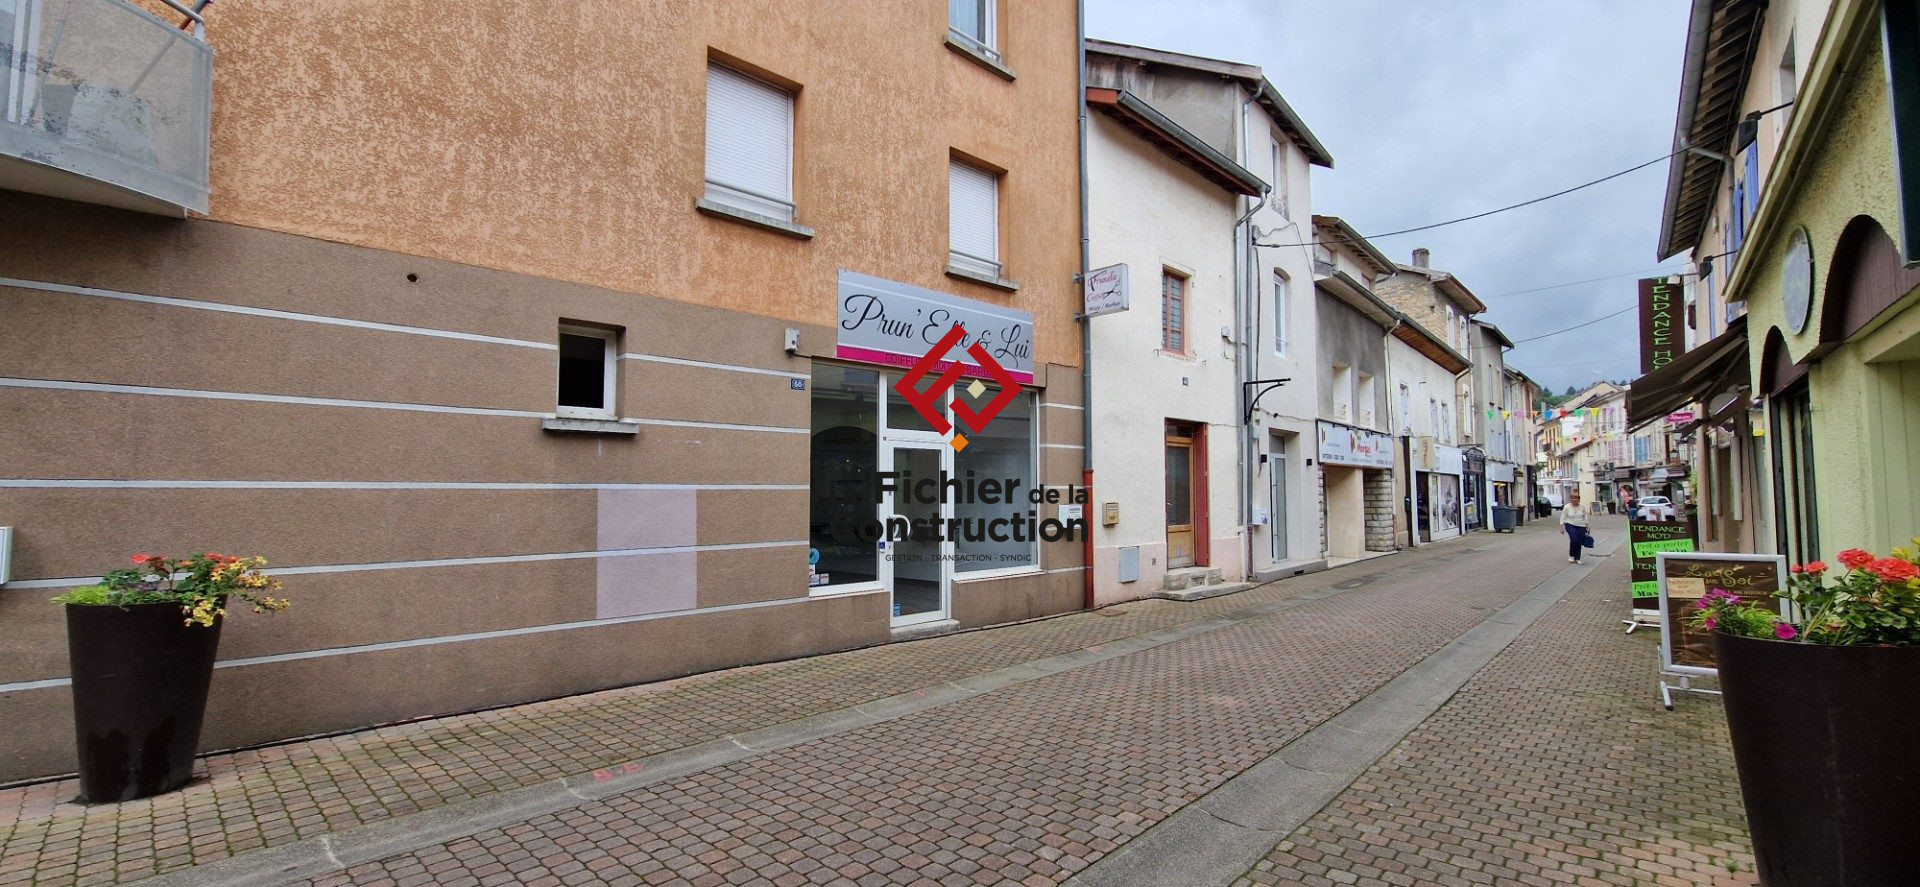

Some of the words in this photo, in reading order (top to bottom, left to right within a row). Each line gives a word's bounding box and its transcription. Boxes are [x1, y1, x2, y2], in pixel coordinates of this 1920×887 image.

[1652, 278, 1672, 345] TENDANCE
[977, 329, 993, 351] &
[994, 324, 1030, 369] Lui
[885, 354, 921, 367] COIFFU
[1632, 525, 1686, 534] TENDANCE
[1634, 562, 1657, 570] TEN
